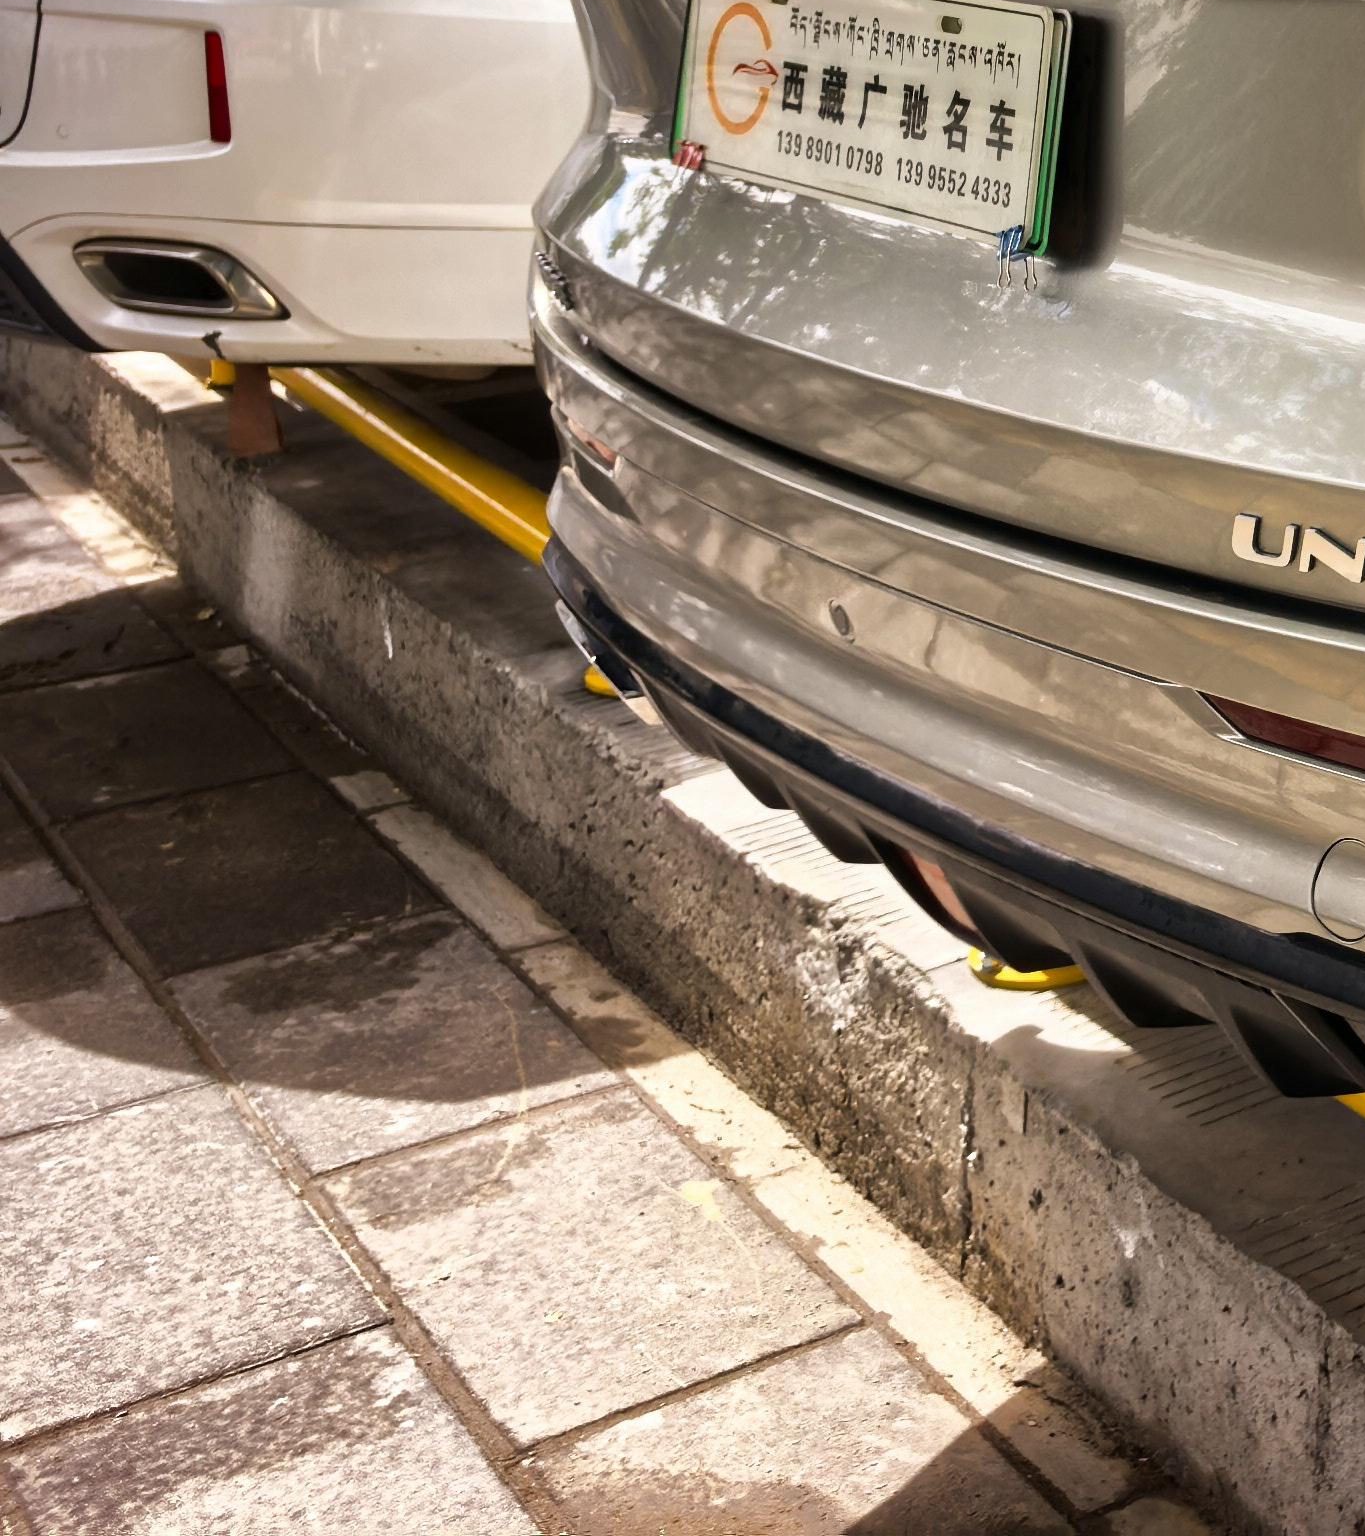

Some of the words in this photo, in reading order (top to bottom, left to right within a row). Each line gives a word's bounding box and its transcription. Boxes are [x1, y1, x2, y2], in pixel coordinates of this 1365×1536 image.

[781, 59, 1017, 162] 西藏广驰名车
